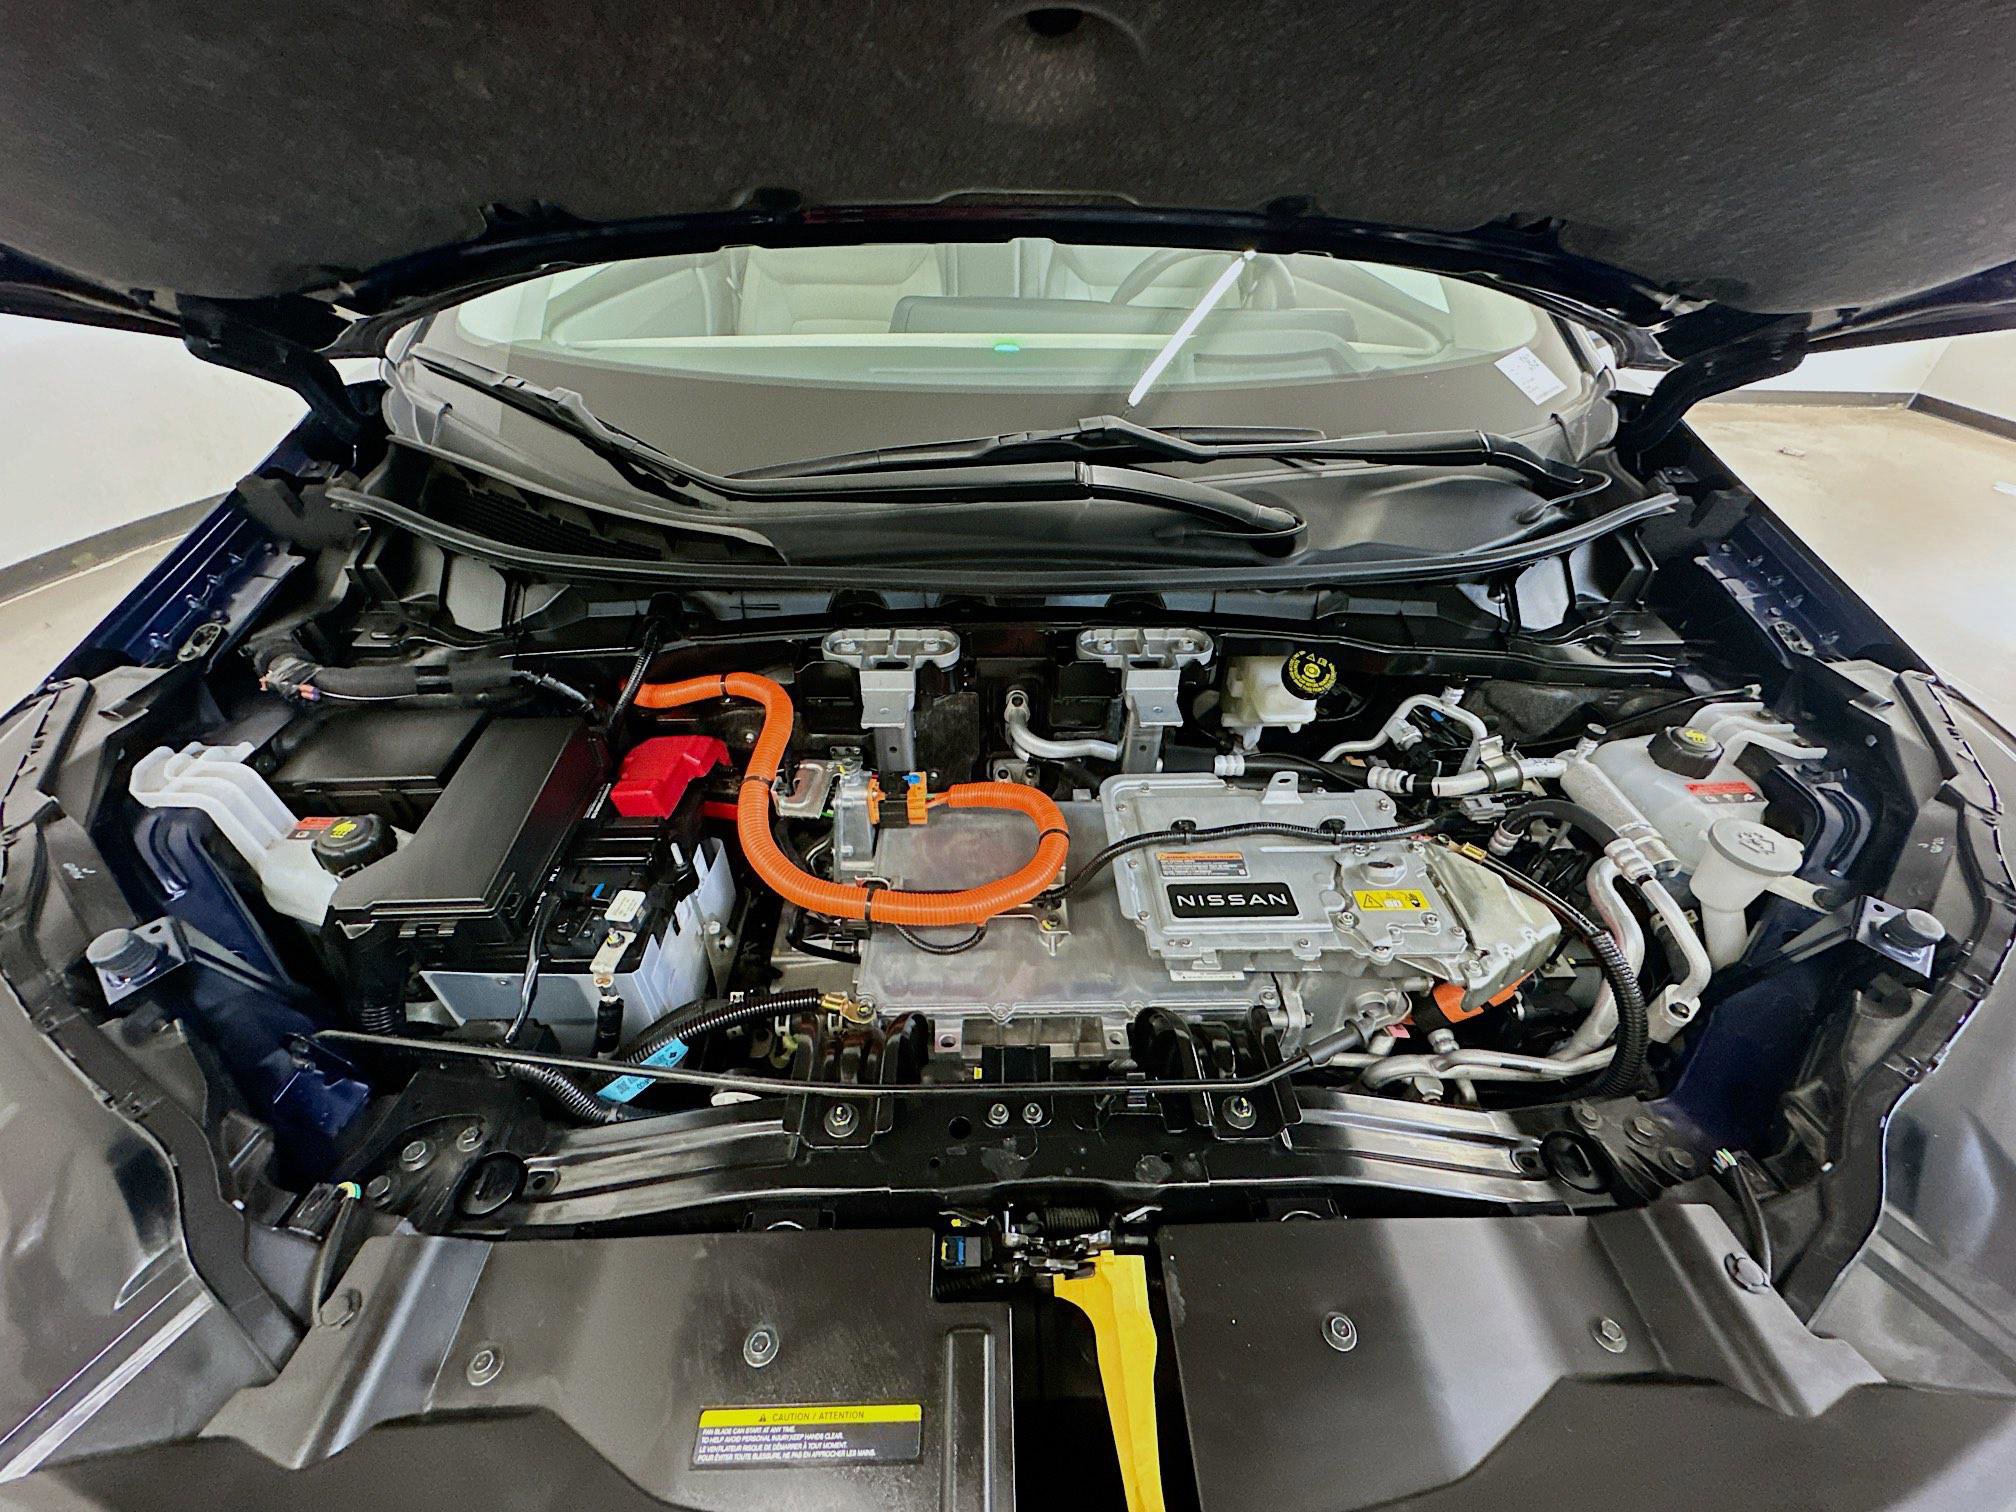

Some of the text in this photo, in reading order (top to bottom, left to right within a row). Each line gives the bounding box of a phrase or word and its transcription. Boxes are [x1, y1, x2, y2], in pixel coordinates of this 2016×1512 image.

[1176, 893, 1288, 907] NISSAN
[772, 1413, 809, 1422] CAUTION
[819, 1411, 864, 1420] ATTENTION
[701, 1436, 710, 1444] TO
[724, 1435, 742, 1443] AVOID
[742, 1434, 770, 1442] PERSONAL
[808, 1442, 822, 1450] TOUT
[697, 1454, 714, 1462] POUR
[734, 1453, 751, 1461] TOUTE
[791, 1451, 803, 1459] PAS
[811, 1450, 846, 1458] APPROCHER
